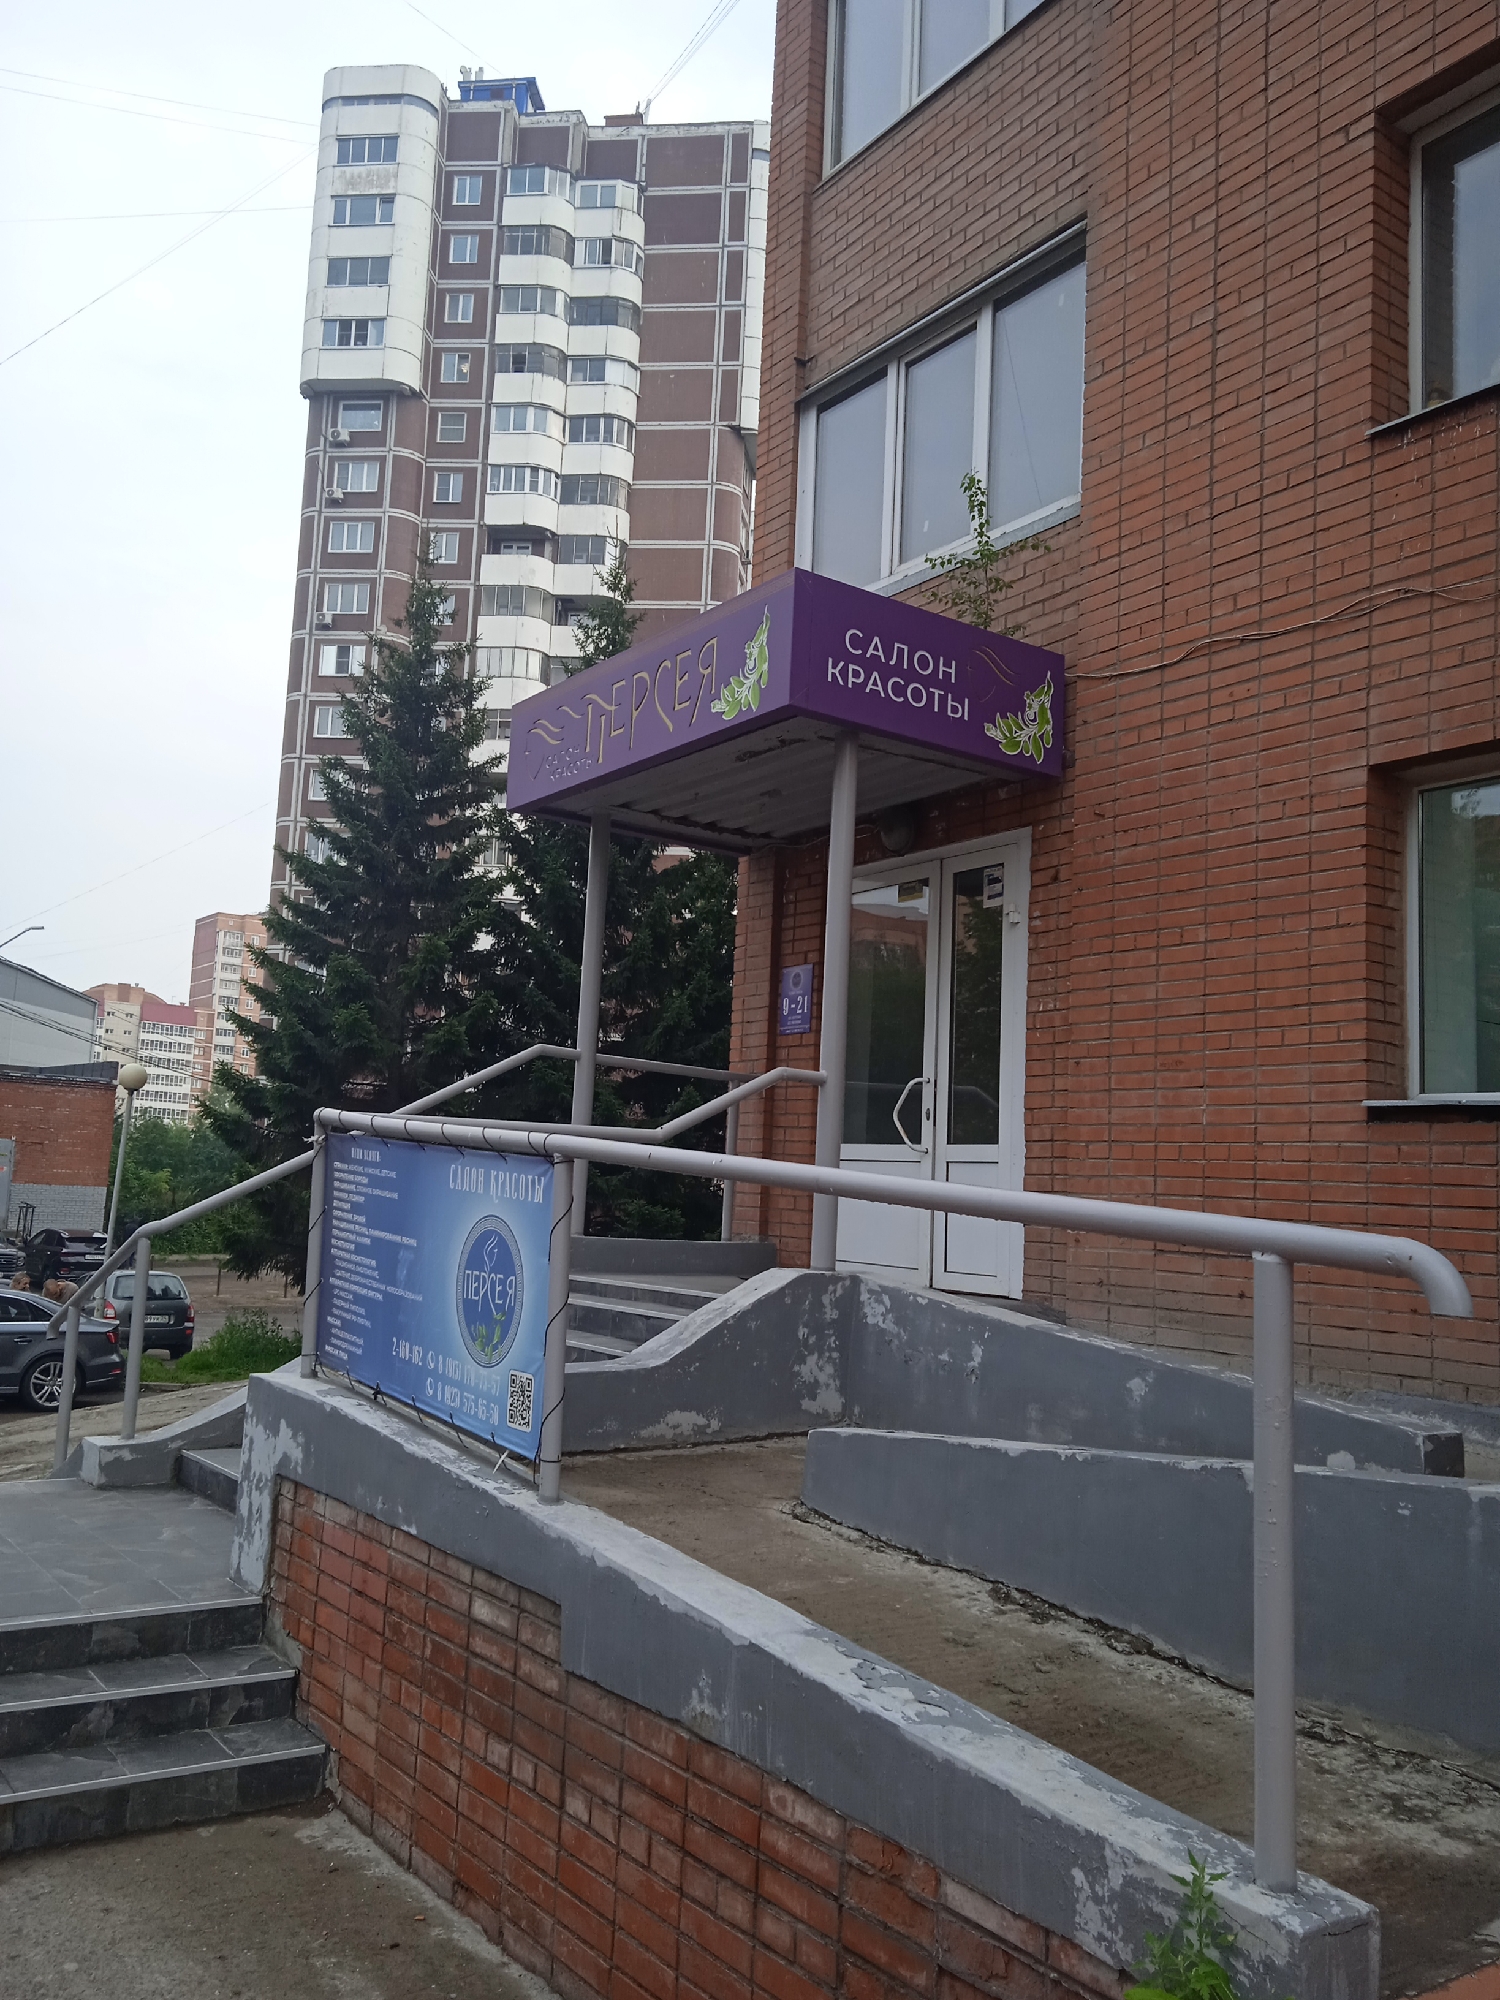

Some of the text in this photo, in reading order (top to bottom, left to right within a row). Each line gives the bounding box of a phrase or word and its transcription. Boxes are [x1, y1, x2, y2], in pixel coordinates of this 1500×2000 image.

[844, 628, 957, 685] САЛОН
[581, 636, 718, 764] ПЕРСЕЯ
[826, 657, 970, 722] КРАСОТЫ
[449, 1164, 545, 1204] САЛОН КРАСОТЫ
[463, 1269, 516, 1316] ПЕРСЕЯ
[438, 1354, 443, 1374] 8
[437, 1381, 442, 1402] 8
